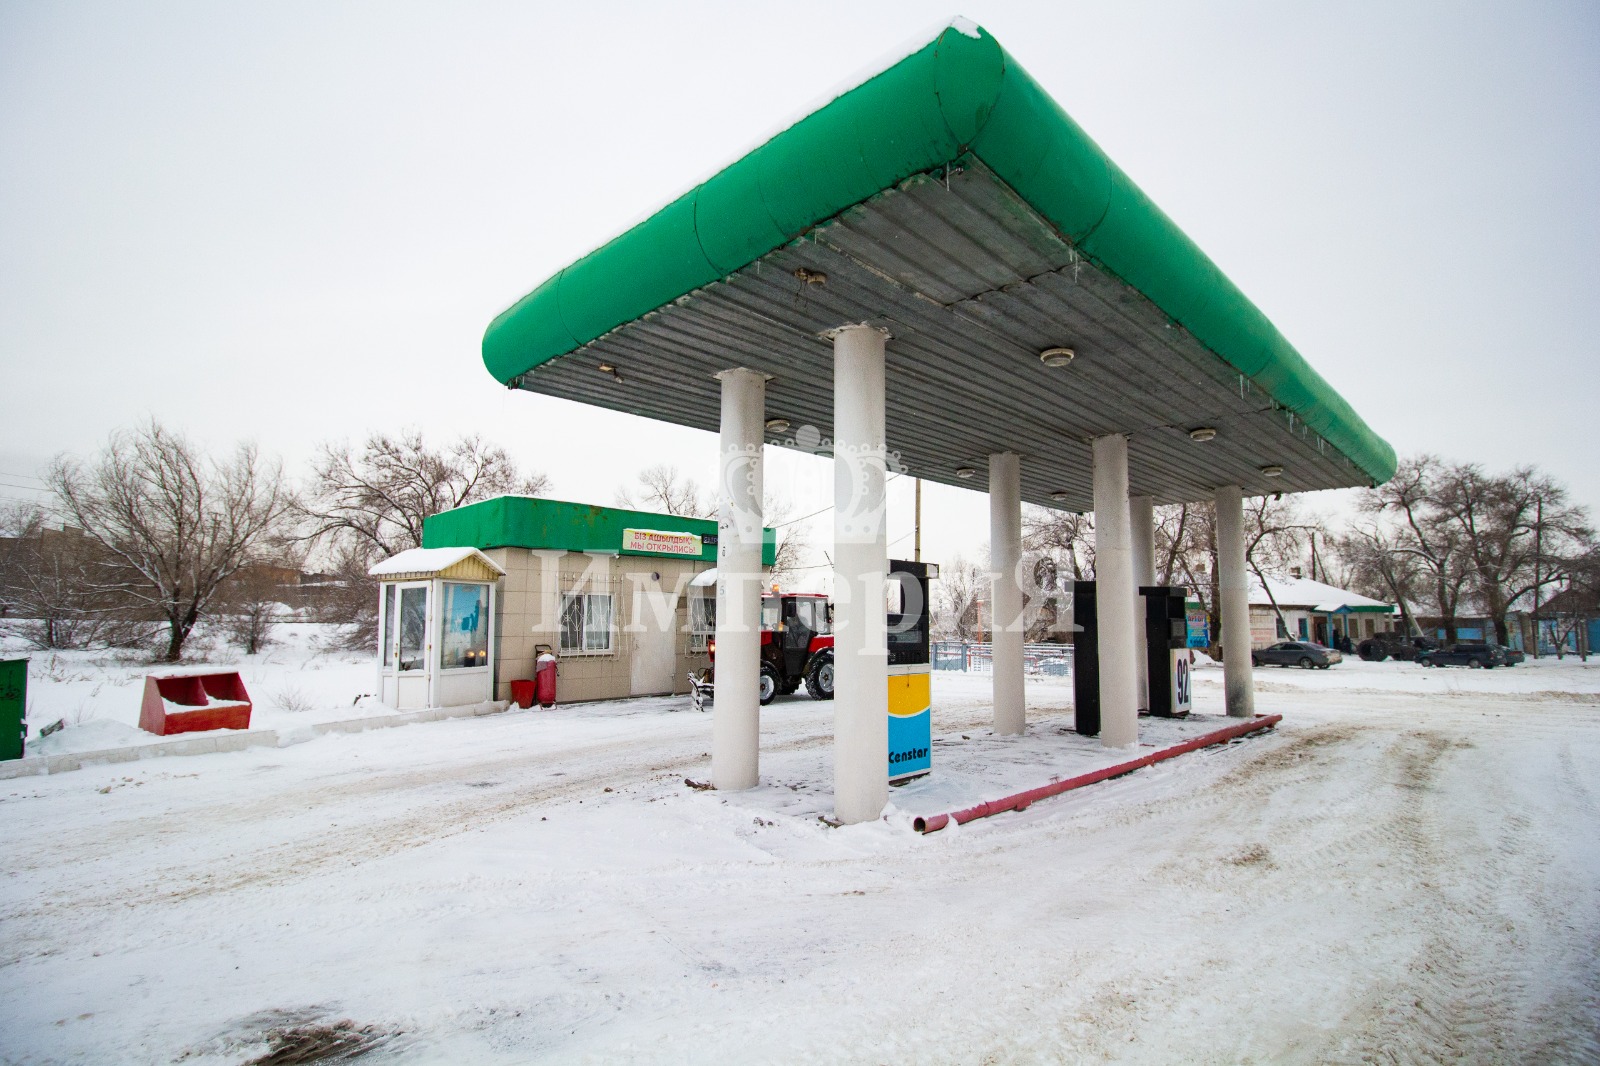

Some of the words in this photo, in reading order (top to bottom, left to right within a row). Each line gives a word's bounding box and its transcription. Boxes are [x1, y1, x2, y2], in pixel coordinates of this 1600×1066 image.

[634, 532, 647, 541] БІЗ
[630, 541, 645, 550] МЫ
[646, 543, 696, 554] ОТКРЫЛИСЬ!
[1177, 658, 1189, 705] 92
[888, 748, 928, 764] Censtar
